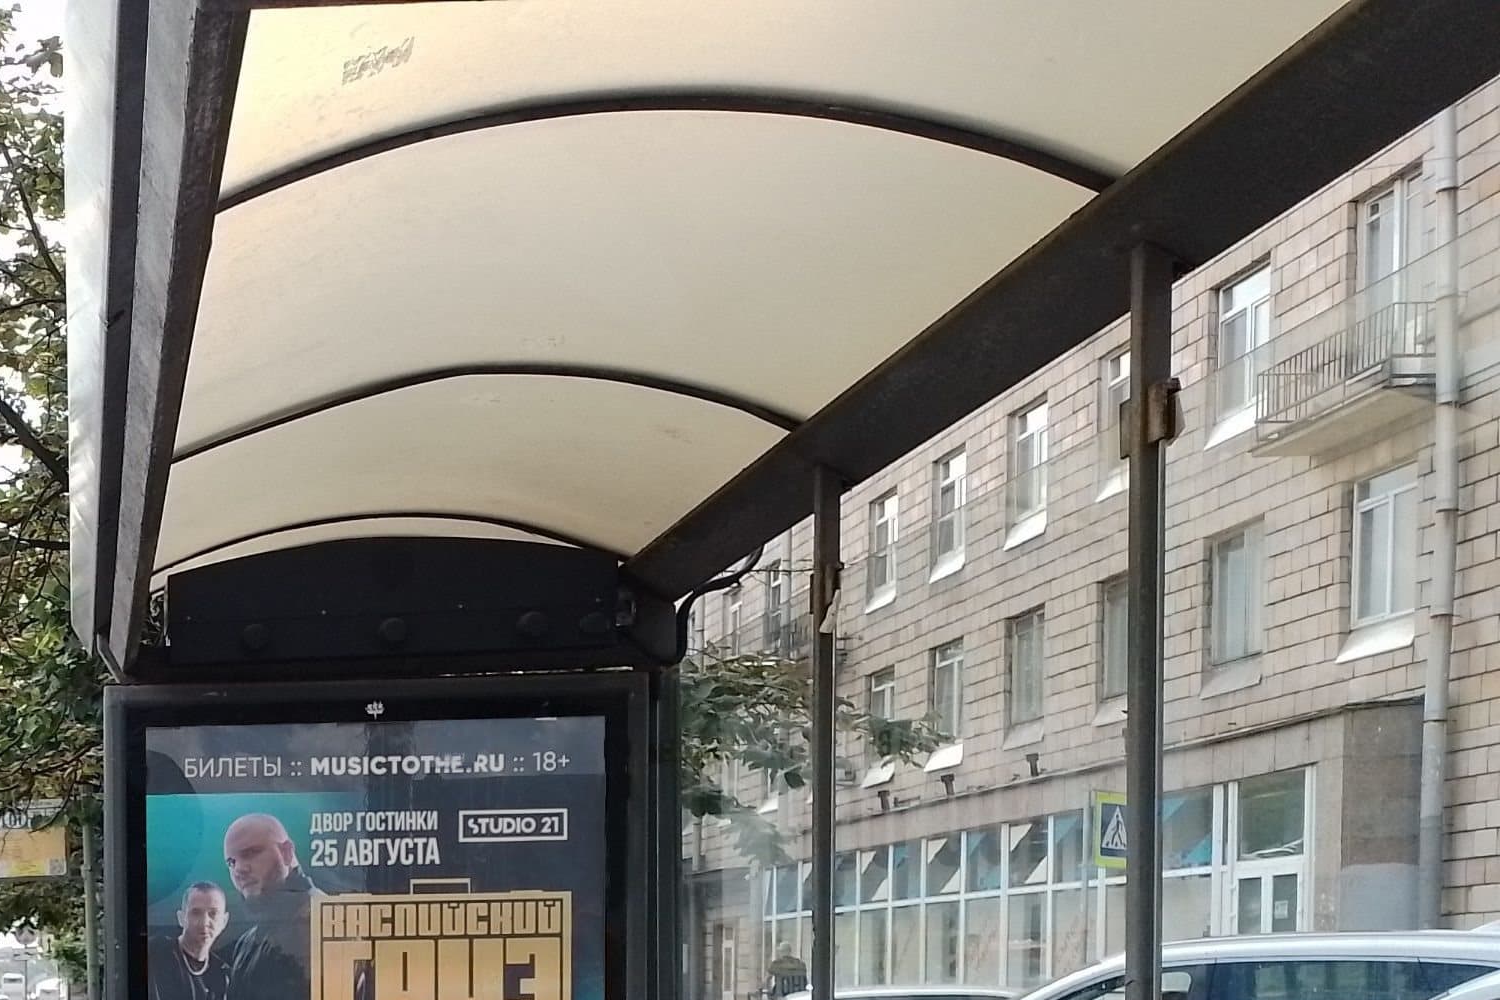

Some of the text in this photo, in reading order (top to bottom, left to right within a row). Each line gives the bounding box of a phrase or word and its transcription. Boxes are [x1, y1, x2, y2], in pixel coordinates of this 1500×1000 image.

[184, 756, 282, 778] БИЛЕТЫ
[311, 753, 505, 776] MUSICTOTHE.RU
[532, 751, 570, 772] 18+
[309, 811, 438, 834] ДВОР ГОСТИНКИ
[468, 817, 560, 835] STUDIO 21
[311, 838, 440, 867] 25 АВГУСТА
[322, 900, 562, 938] КАСПИЙСКИЙ
